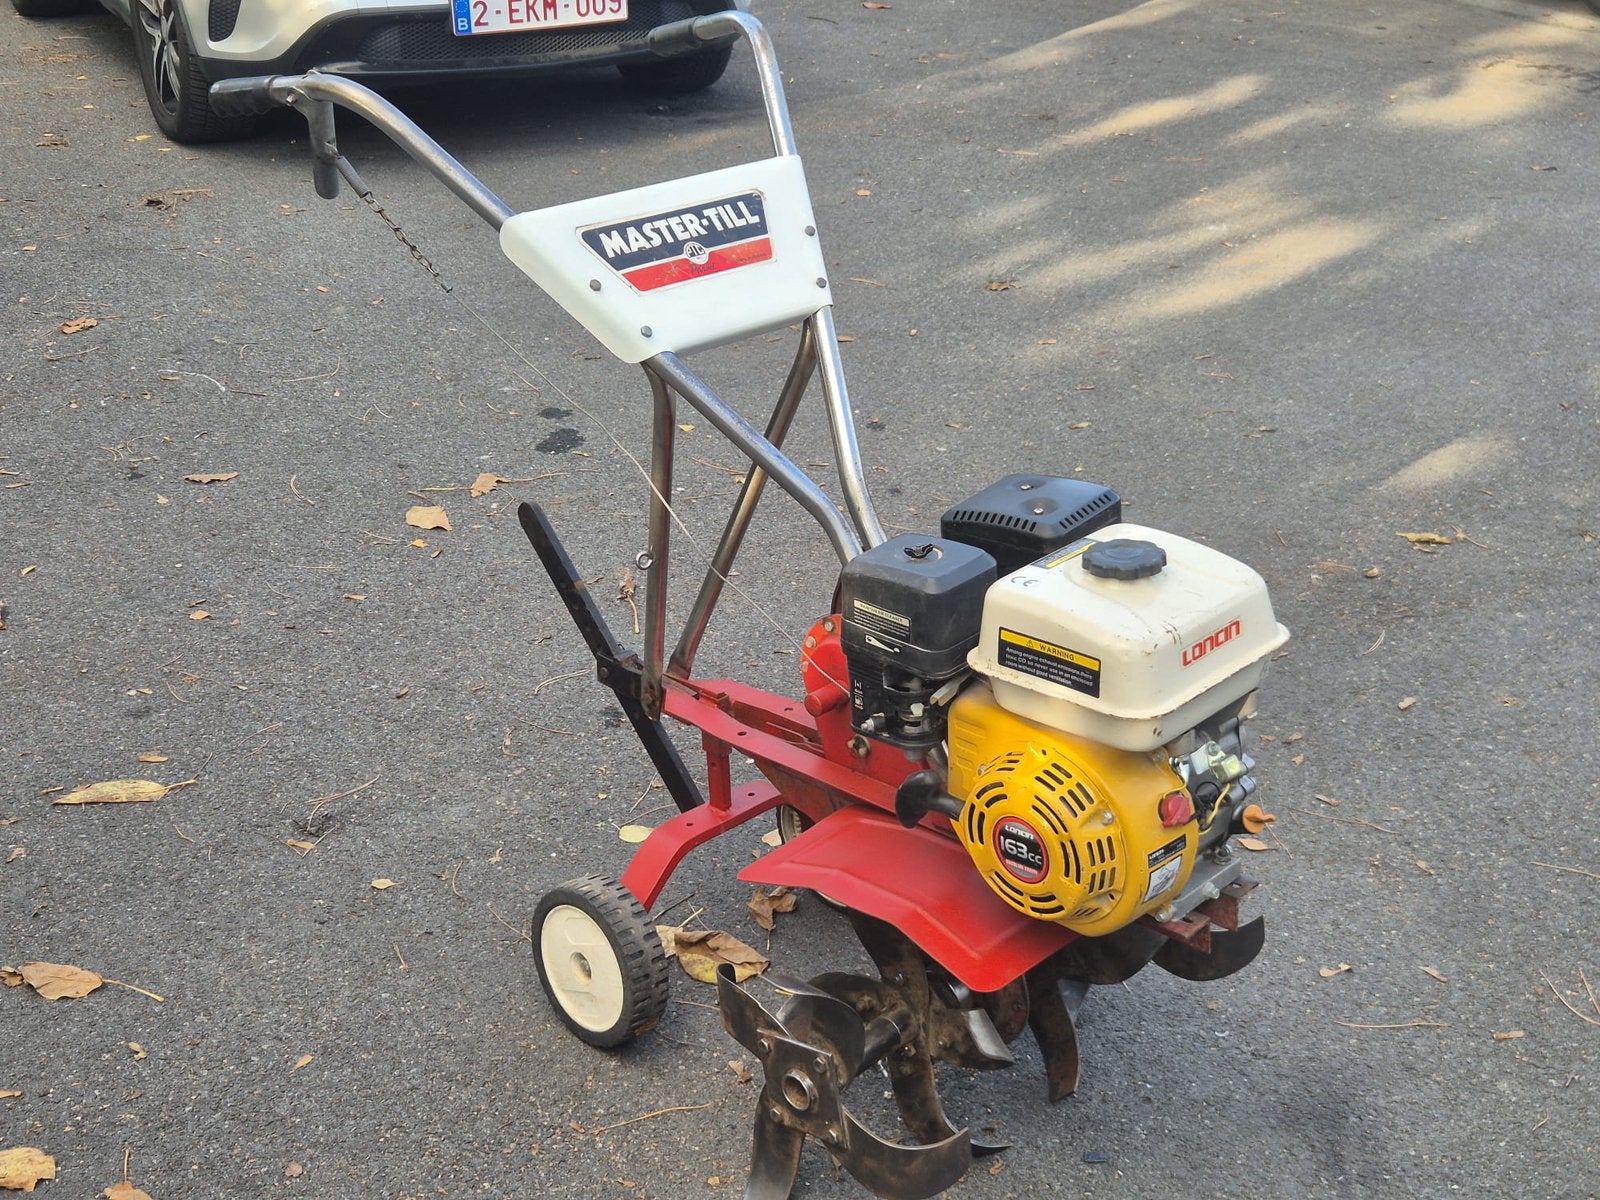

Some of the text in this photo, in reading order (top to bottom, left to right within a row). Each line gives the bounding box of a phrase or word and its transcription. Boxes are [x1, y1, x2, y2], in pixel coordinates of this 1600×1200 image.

[457, 17, 469, 31] B
[1039, 643, 1074, 660] WARNING
[1000, 835, 1042, 864] 163cc
